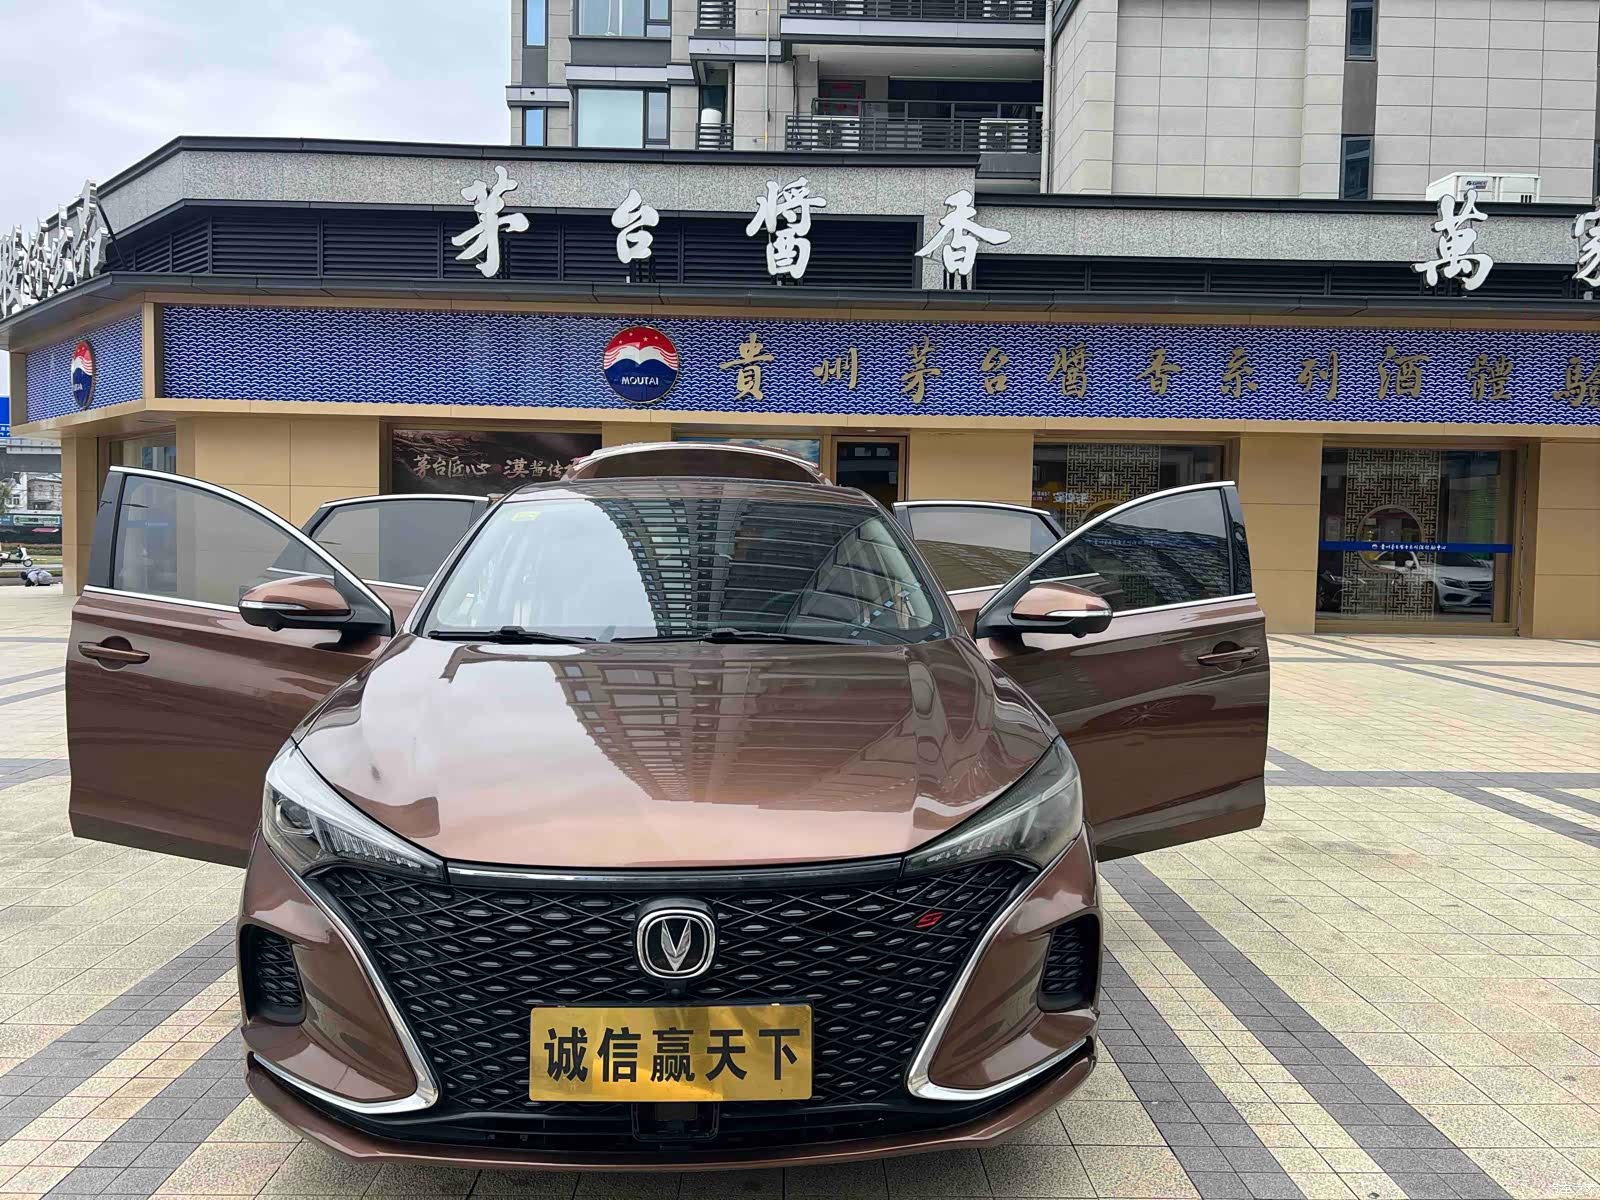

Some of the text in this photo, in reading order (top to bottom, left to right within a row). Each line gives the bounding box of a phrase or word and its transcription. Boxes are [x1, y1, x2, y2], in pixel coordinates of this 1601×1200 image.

[621, 376, 659, 386] MOUTAI
[544, 1027, 801, 1083] 诚信赢天下
